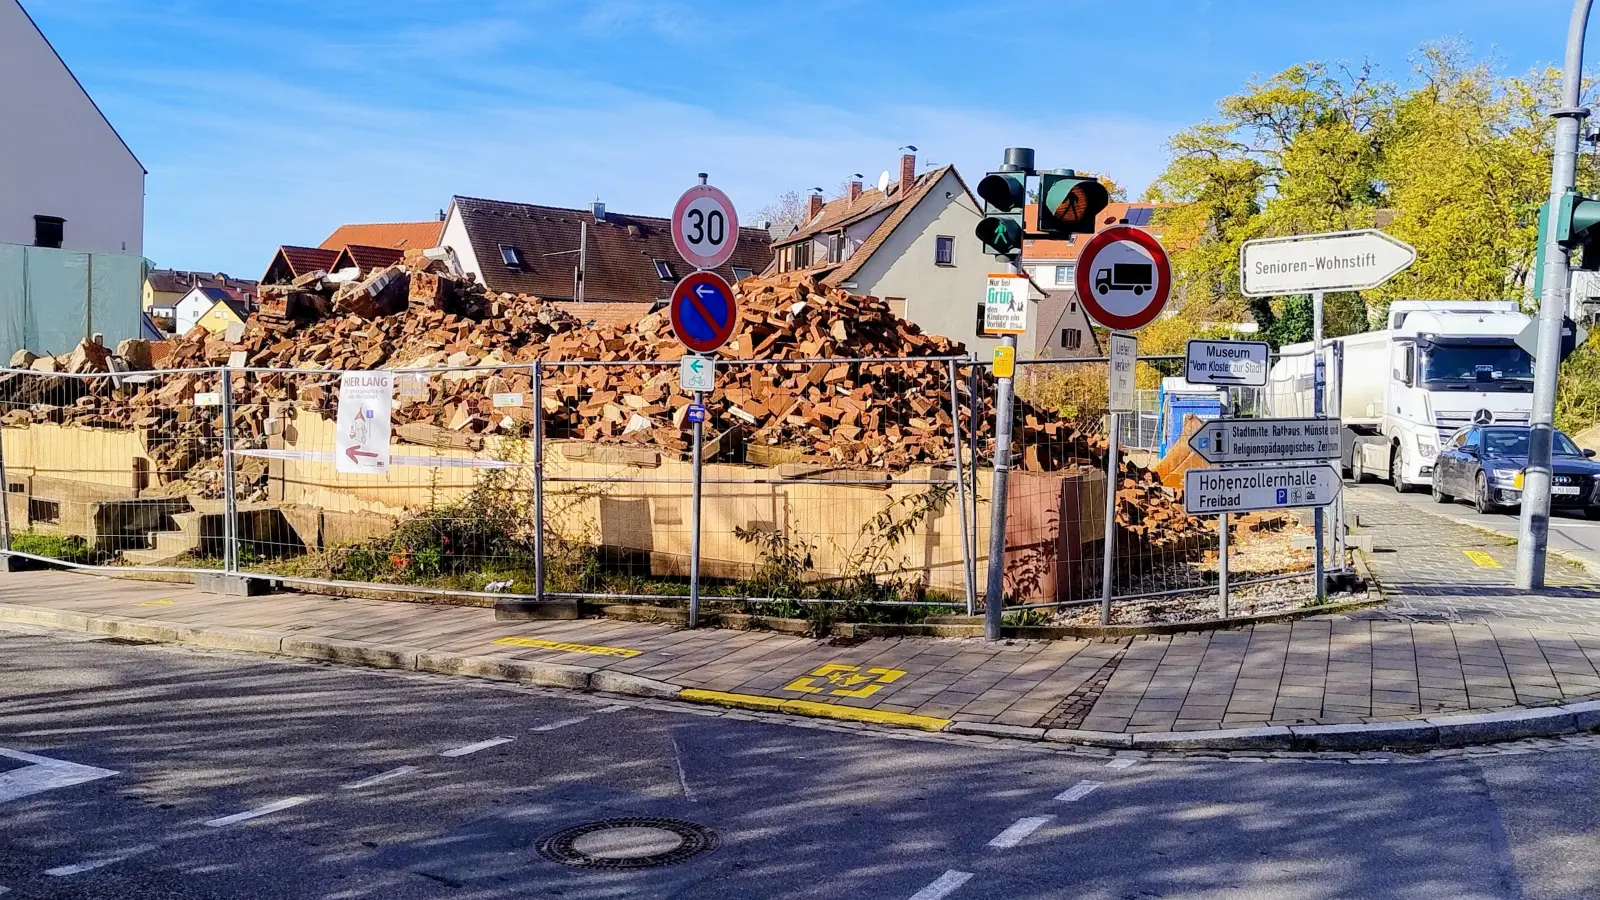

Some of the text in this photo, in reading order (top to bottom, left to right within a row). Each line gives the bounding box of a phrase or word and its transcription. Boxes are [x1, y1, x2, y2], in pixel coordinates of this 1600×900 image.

[686, 208, 724, 246] 30
[1255, 252, 1376, 275] Senioren-Wohnstift
[987, 287, 1014, 305] Grün
[1206, 345, 1250, 359] Museum
[1208, 360, 1232, 373] Kloster
[1232, 364, 1243, 373] zur
[344, 376, 388, 387] HIER LANG
[1304, 424, 1329, 436] Münste
[1233, 440, 1315, 457] Religionspädagogisches
[1199, 471, 1317, 491] Hohenzollernhalle
[1199, 493, 1241, 508] Freibad
